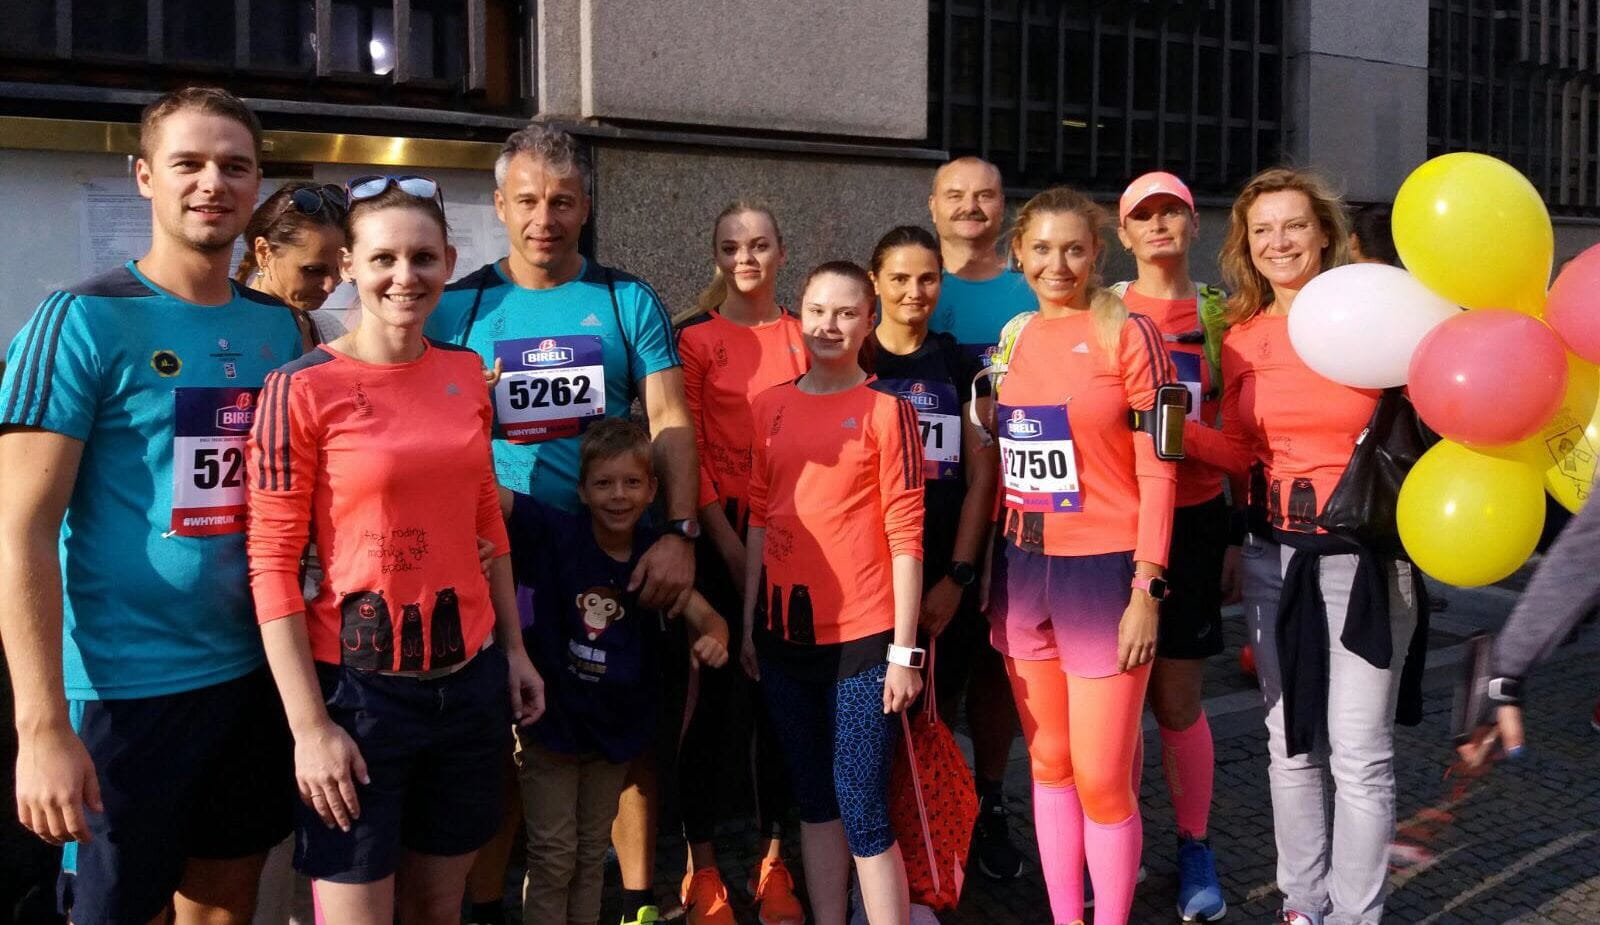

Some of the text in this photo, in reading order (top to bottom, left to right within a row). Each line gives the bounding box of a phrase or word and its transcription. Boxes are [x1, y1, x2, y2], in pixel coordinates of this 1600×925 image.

[527, 350, 568, 362] BIRELL
[509, 375, 592, 409] 5262
[223, 412, 253, 424] BIRE
[918, 421, 943, 449] 71
[194, 447, 247, 489] 52
